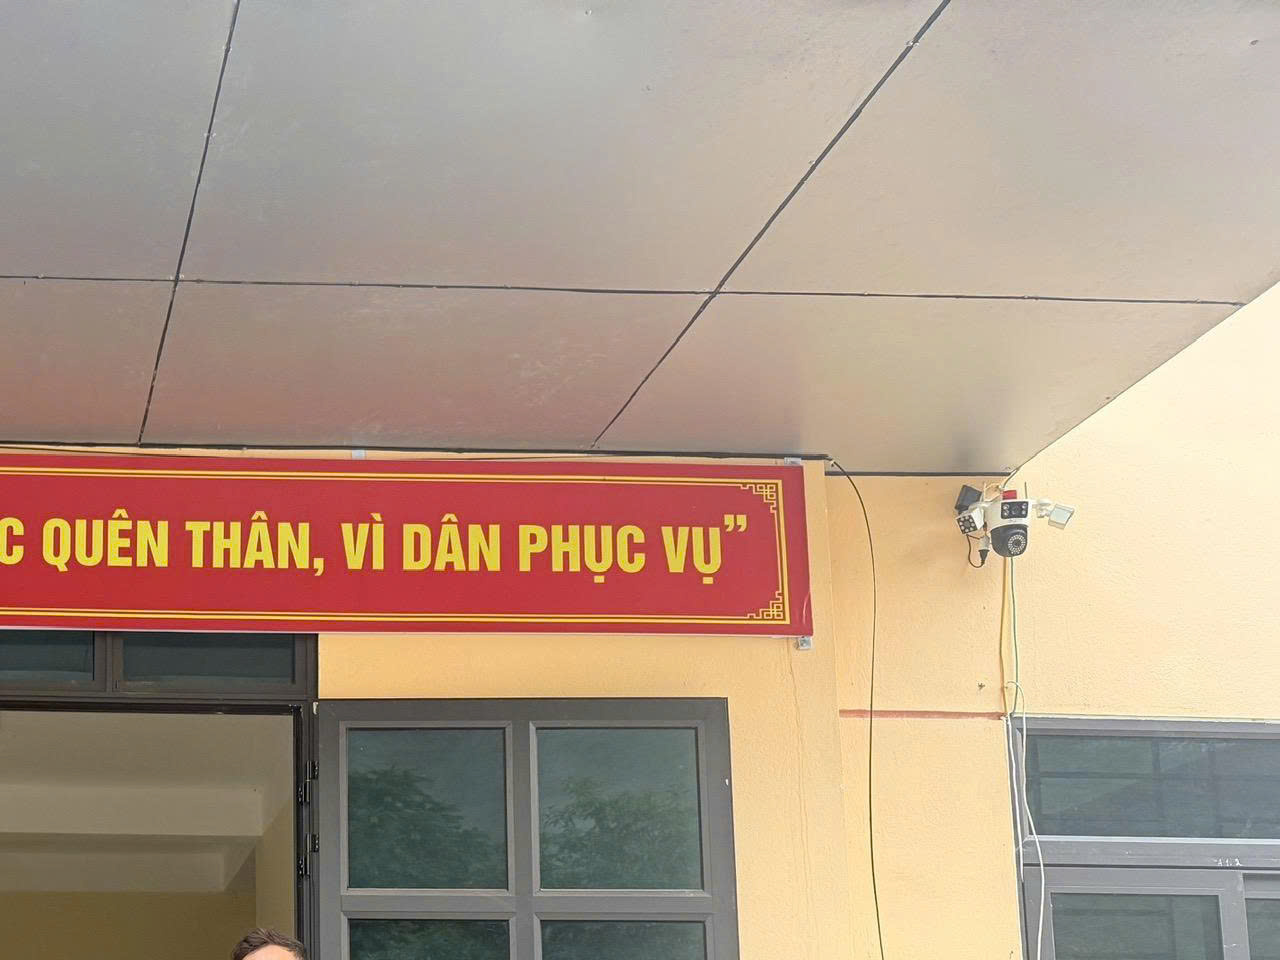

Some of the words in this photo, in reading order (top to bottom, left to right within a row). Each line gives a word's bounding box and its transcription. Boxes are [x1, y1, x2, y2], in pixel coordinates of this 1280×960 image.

[42, 508, 169, 572] QUÊN
[184, 510, 325, 577] THÂN,
[340, 512, 385, 571] VÌ
[402, 513, 501, 572] DÂN
[518, 524, 646, 584] PHỤC
